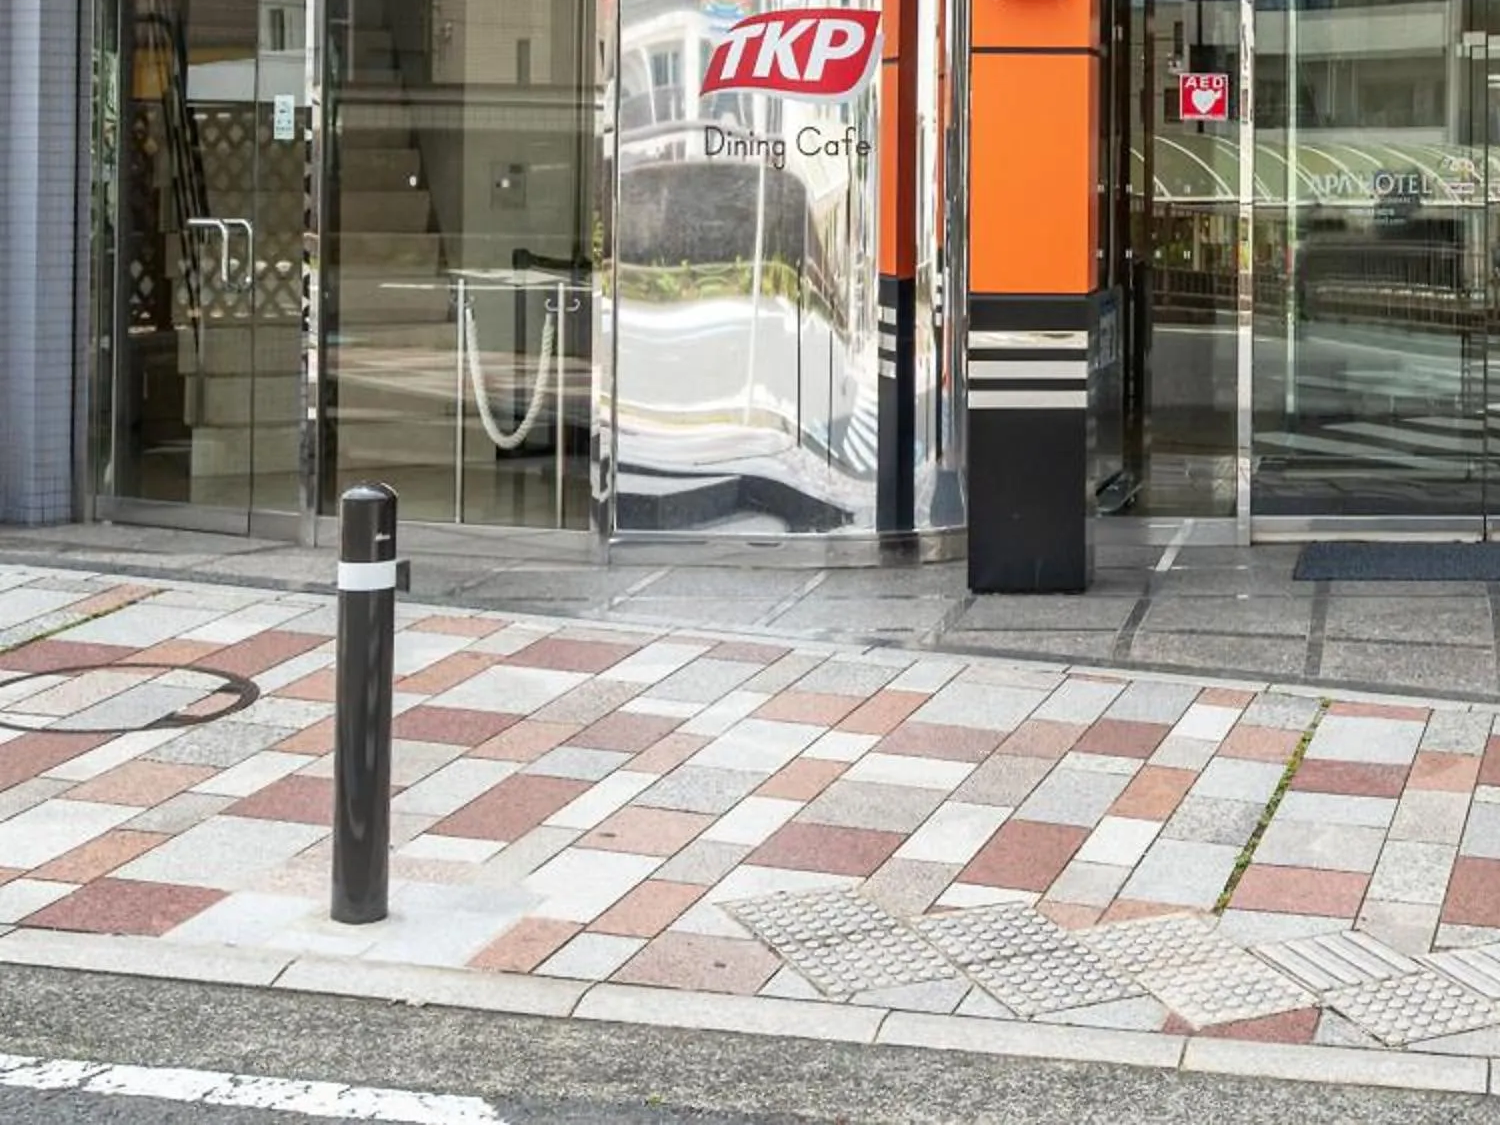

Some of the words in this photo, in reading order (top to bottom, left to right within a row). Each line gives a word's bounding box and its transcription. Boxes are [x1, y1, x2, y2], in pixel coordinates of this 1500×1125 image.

[719, 18, 866, 82] TKP
[1184, 76, 1224, 89] AED
[704, 126, 786, 170] Dining
[796, 126, 872, 157] Cafe
